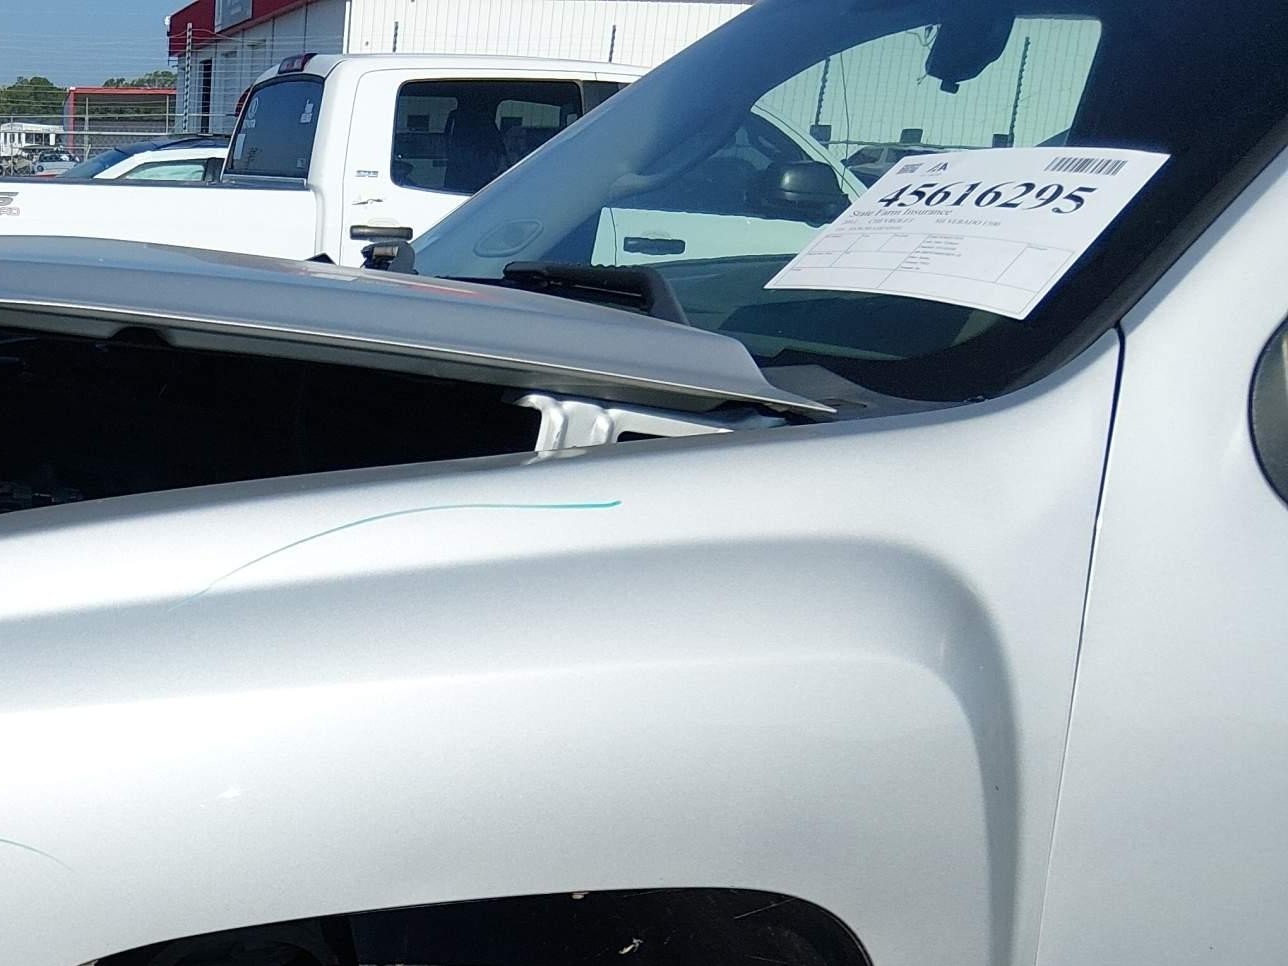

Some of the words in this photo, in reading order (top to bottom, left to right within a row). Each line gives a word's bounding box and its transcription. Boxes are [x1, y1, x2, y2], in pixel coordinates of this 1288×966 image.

[878, 181, 1098, 214] 45616295
[849, 208, 873, 217] State
[875, 208, 901, 217] Farm
[902, 207, 953, 217] Insurance
